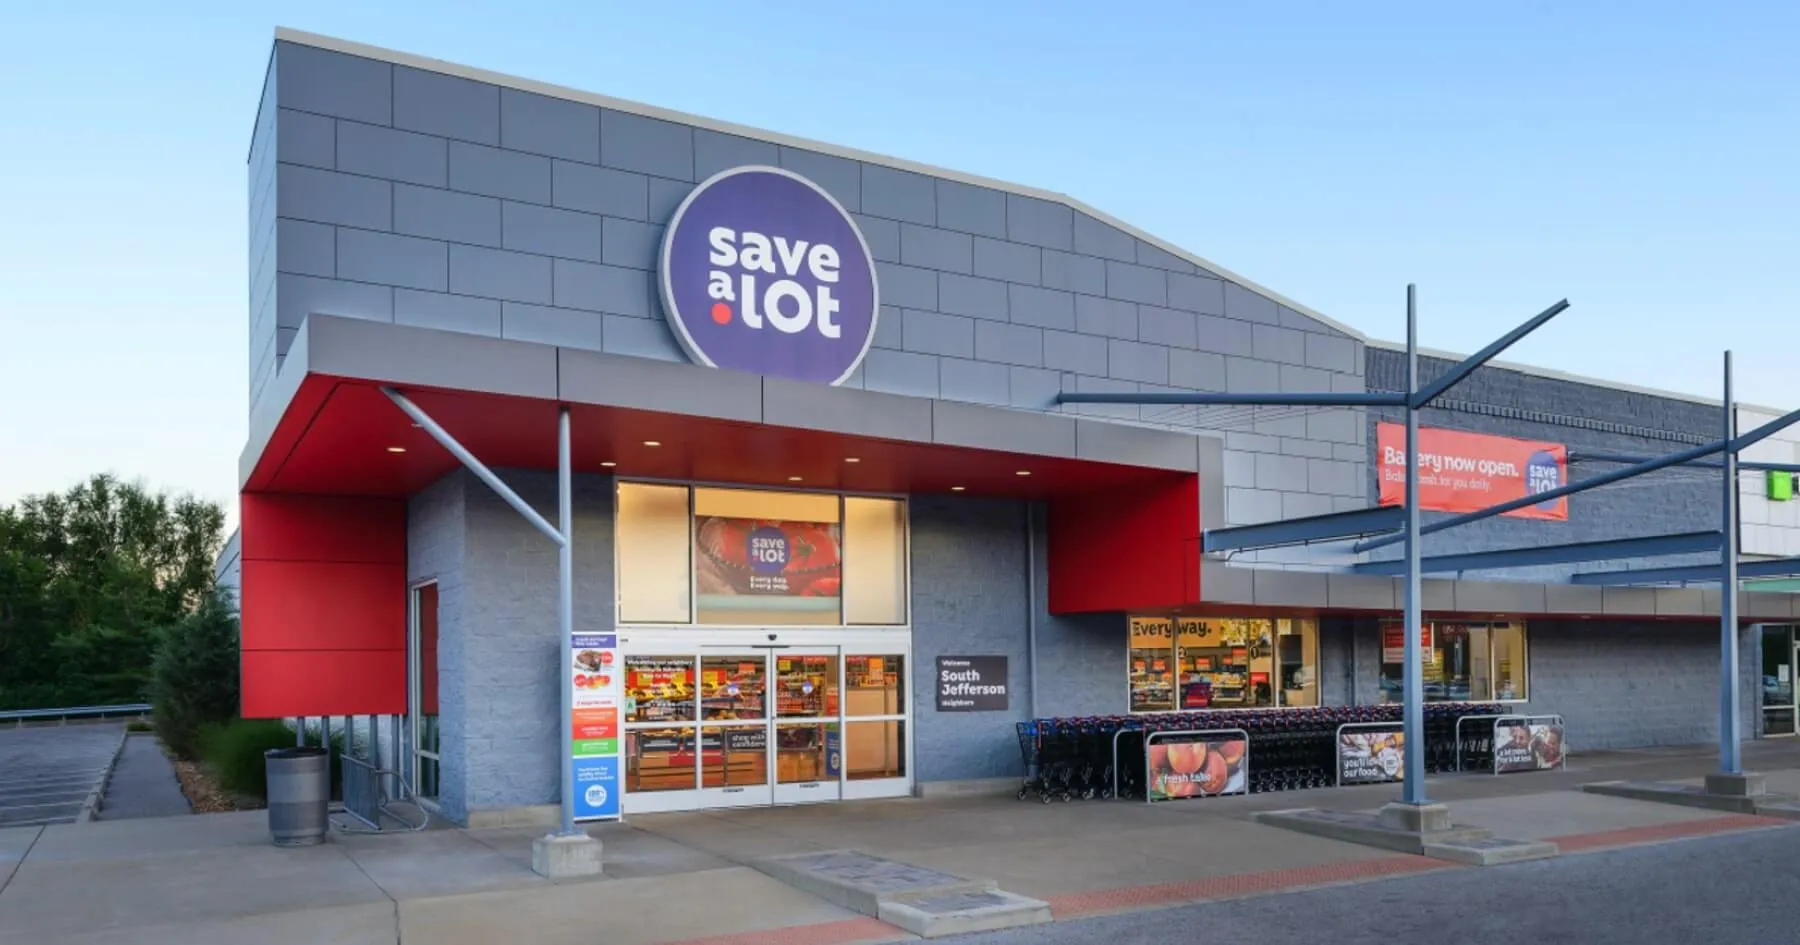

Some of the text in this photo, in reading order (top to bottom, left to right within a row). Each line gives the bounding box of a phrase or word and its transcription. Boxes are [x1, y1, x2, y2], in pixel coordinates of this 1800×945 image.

[708, 226, 841, 282] save
[707, 270, 736, 301] a
[1384, 446, 1519, 478] Baery now open.
[1529, 464, 1557, 479] save
[1453, 479, 1468, 491] you
[752, 537, 785, 549] save
[750, 575, 771, 584] Every
[750, 582, 771, 591] Every
[1133, 621, 1212, 637] Every way.
[942, 669, 980, 682] South
[941, 683, 1005, 695] Jefferson
[1358, 766, 1378, 777] food
[1164, 774, 1189, 785] fresh
